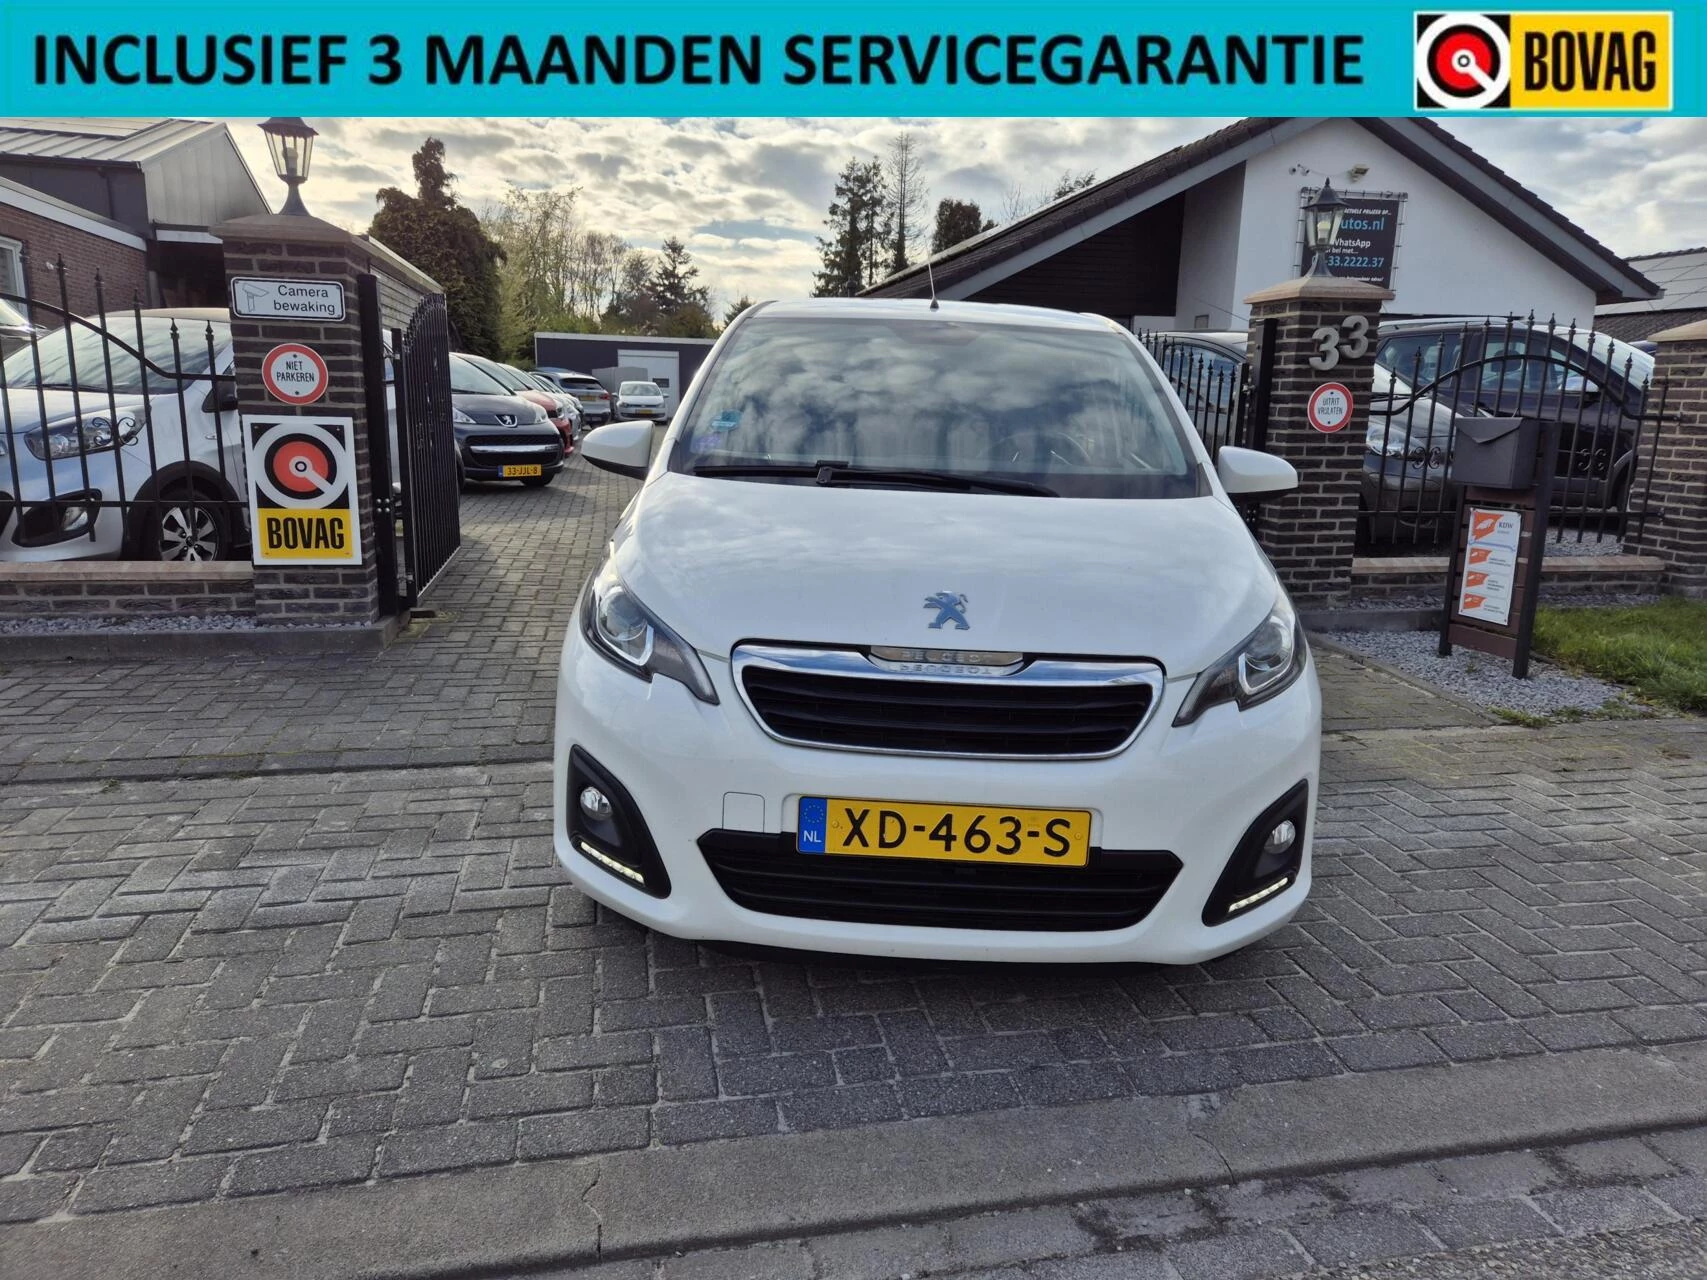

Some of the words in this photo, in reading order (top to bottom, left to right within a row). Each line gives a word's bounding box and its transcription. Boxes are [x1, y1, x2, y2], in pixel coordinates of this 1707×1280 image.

[1340, 217, 1385, 231] utos.nl
[277, 284, 329, 298] Camera
[273, 299, 336, 316] bewaking
[1309, 315, 1369, 370] 33
[285, 360, 303, 371] NIET
[276, 371, 315, 383] PARKEREN
[1322, 397, 1340, 406] UITRIT
[266, 516, 345, 549] BOVAG
[803, 830, 821, 843] NL
[842, 807, 1071, 858] XD-463-S
